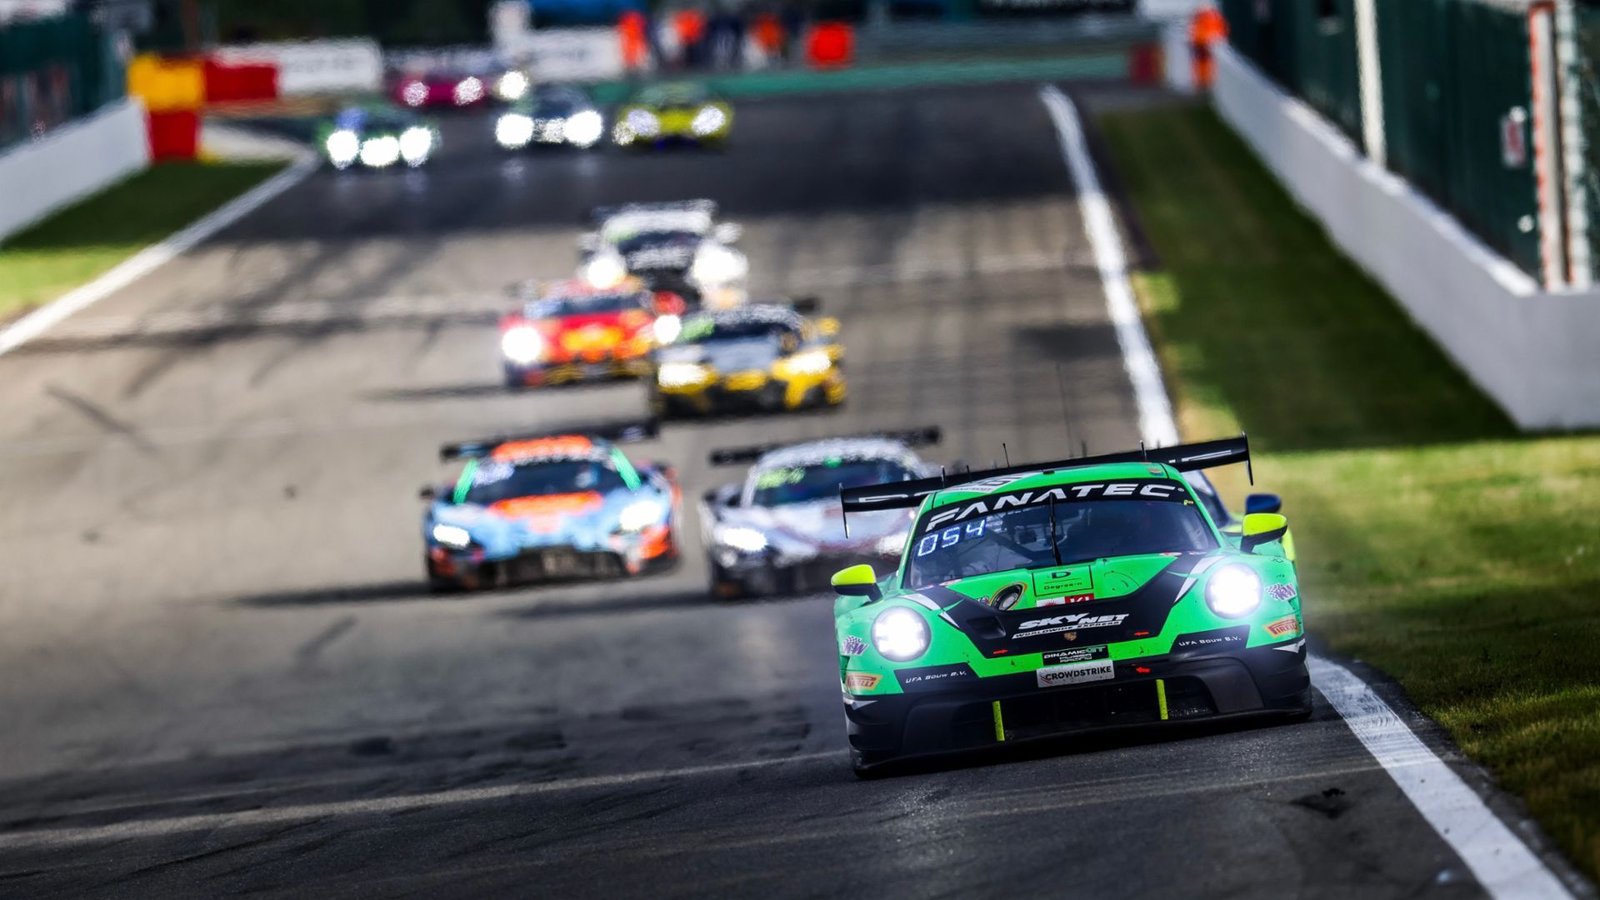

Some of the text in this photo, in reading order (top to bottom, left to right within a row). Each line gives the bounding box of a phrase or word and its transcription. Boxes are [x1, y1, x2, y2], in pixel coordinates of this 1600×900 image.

[926, 483, 1177, 532] FANATEC
[917, 520, 985, 557] 054
[1018, 612, 1130, 630] SKYNET
[905, 675, 922, 684] UFA
[1045, 665, 1112, 681] CROWDSTRIKE
